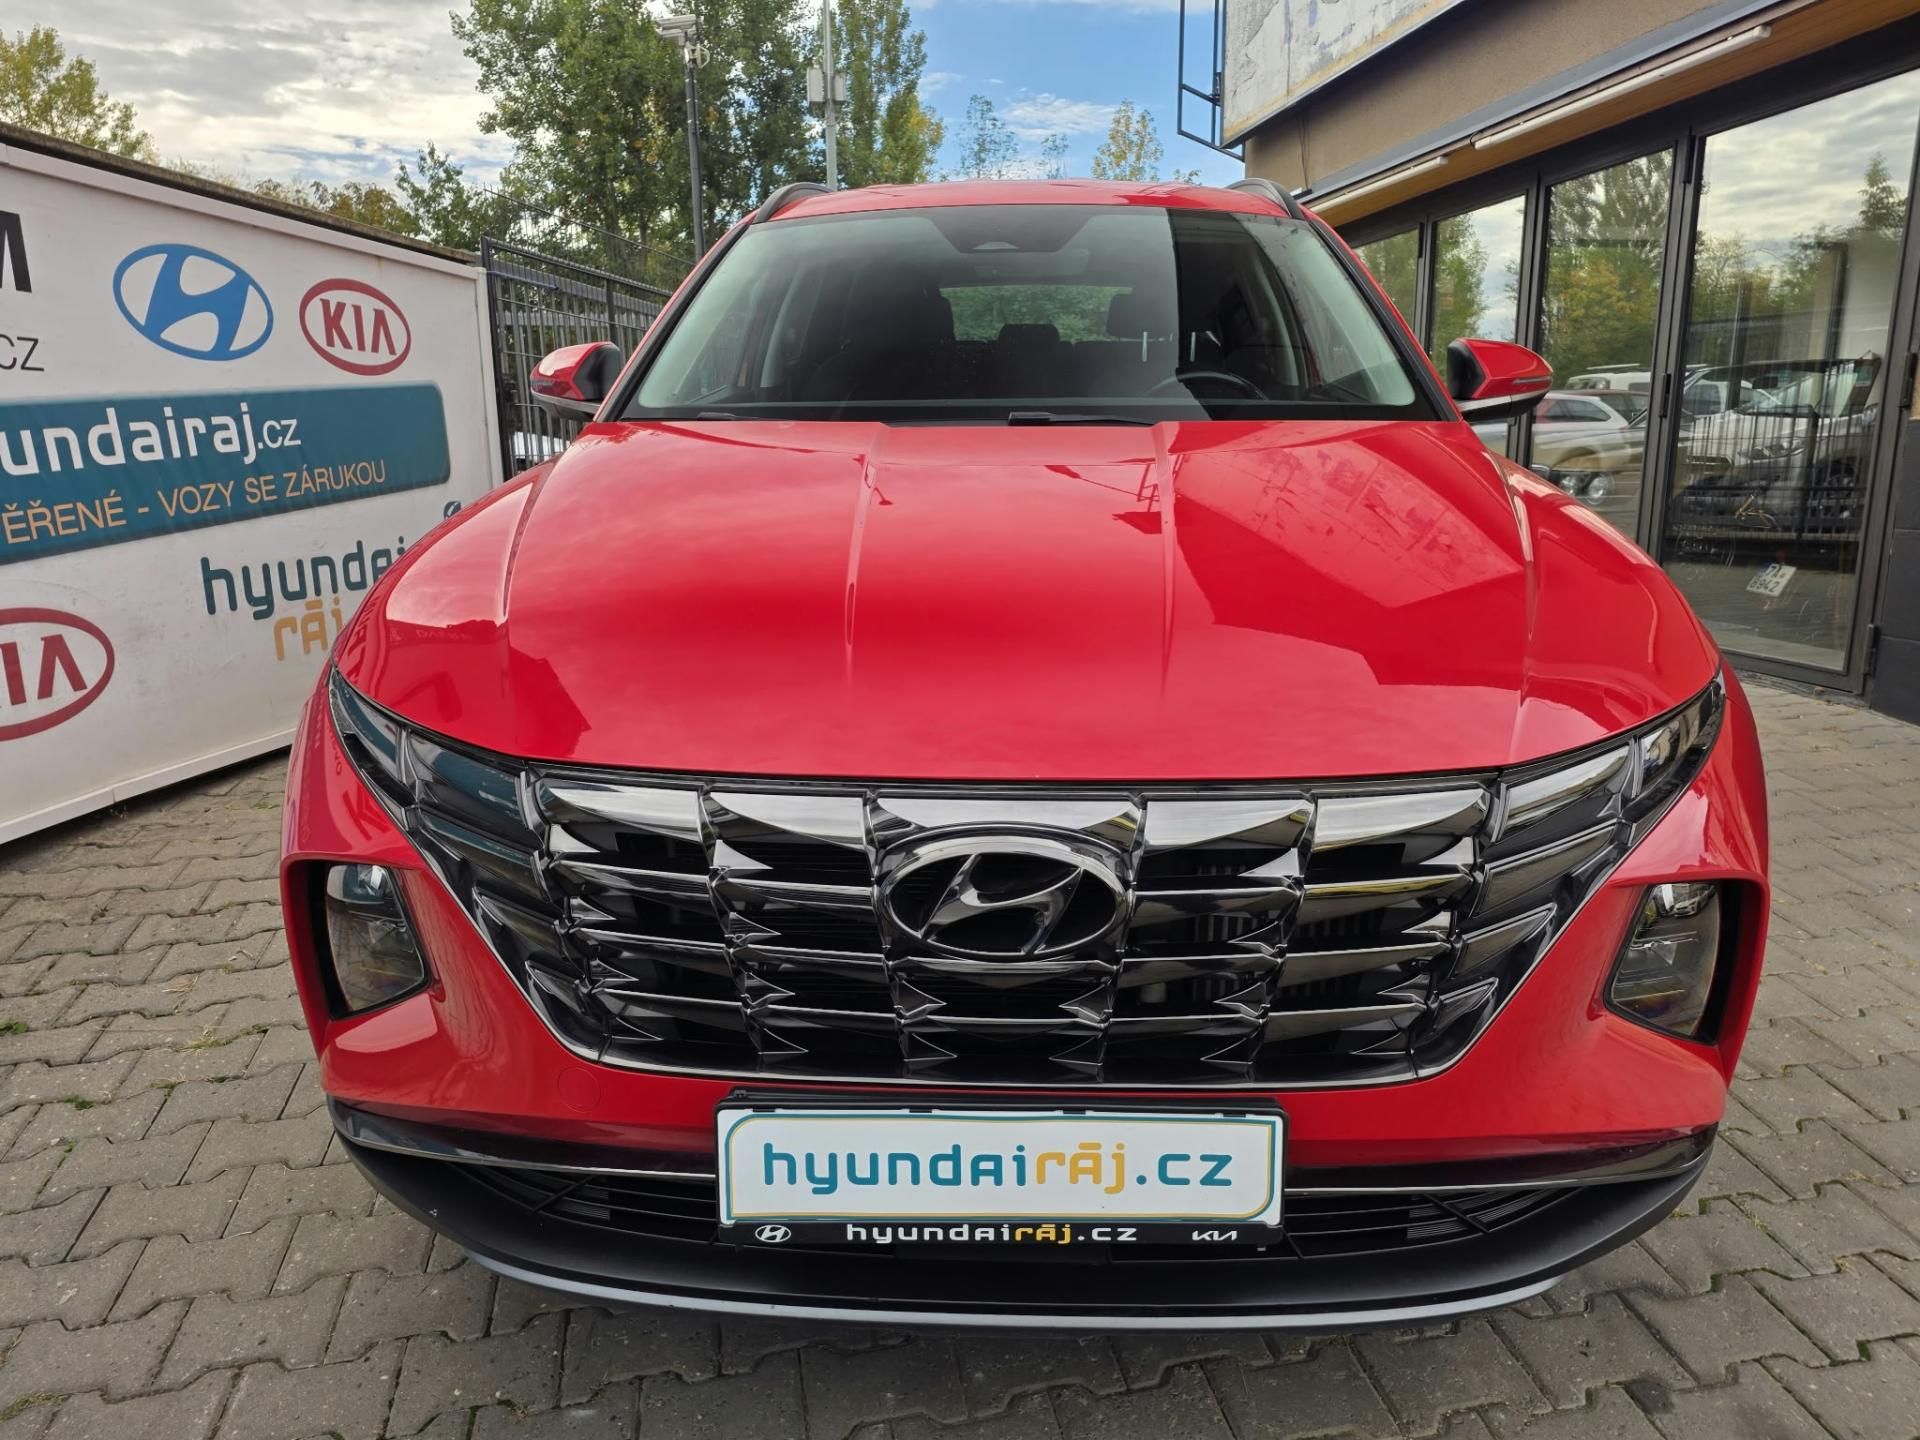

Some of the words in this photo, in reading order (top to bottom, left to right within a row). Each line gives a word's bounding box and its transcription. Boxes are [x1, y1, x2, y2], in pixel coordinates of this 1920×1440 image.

[319, 298, 398, 356] KIA
[1, 489, 127, 544] ĚŘENÉ
[157, 480, 235, 518] VOZY
[244, 475, 279, 504] SE
[283, 459, 387, 498] ZÁRUKOU
